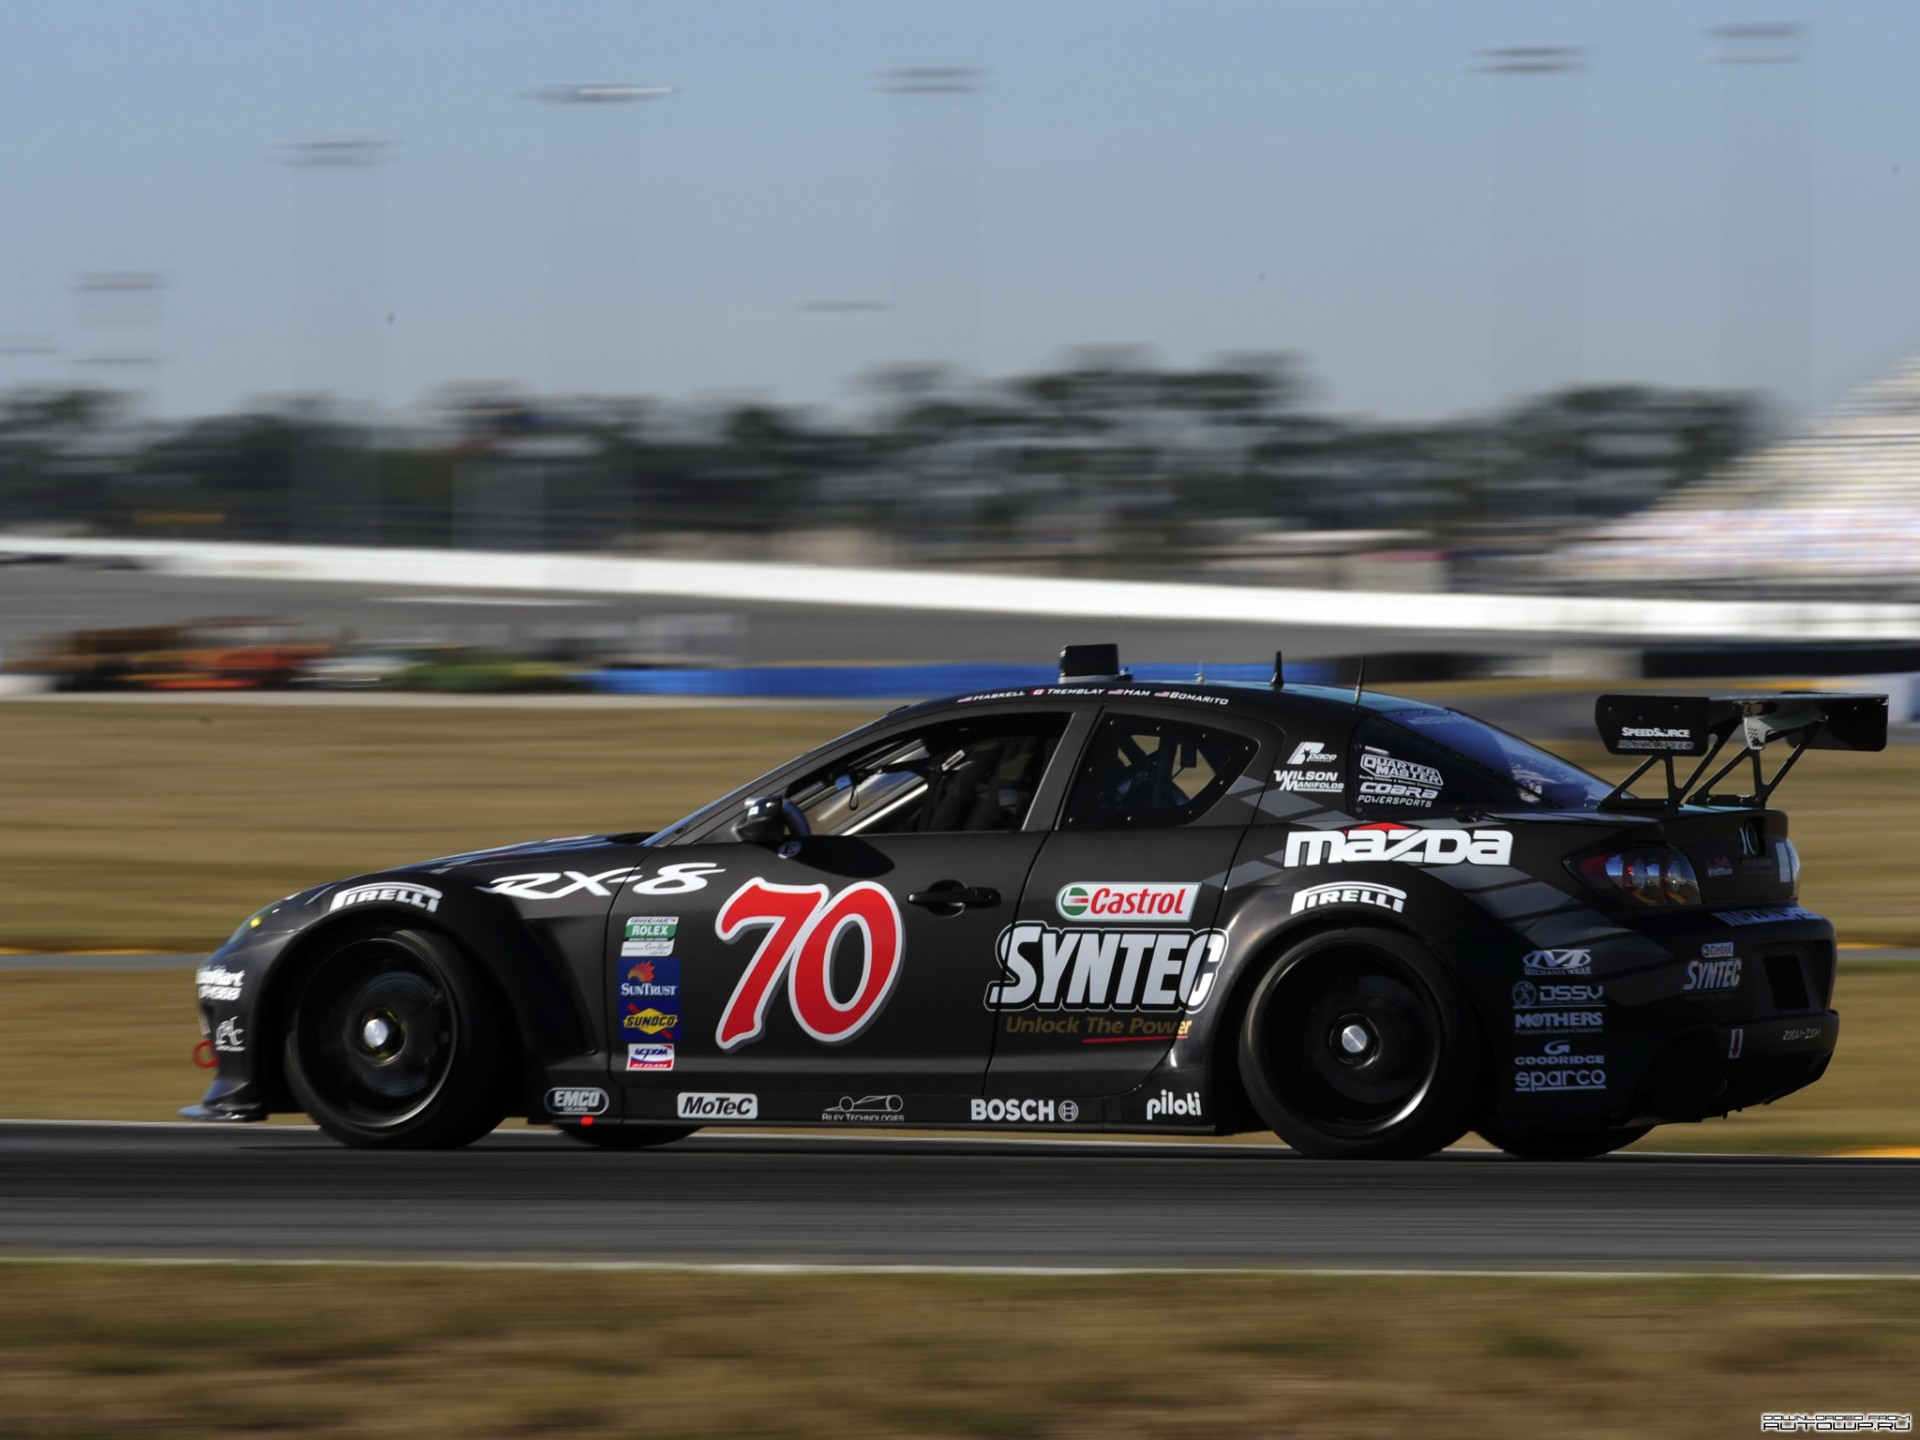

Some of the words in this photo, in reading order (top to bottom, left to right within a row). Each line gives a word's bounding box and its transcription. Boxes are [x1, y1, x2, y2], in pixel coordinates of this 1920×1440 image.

[972, 690, 1025, 701] HASKELL
[1047, 688, 1104, 696] TREMBLAY
[1122, 689, 1150, 697] HAM
[1167, 691, 1229, 706] BOMARITO
[1363, 755, 1438, 776] QUARTER
[1375, 765, 1439, 784] MASTER
[1274, 770, 1338, 782] WILSON
[1279, 781, 1344, 791] MANIFOLDS
[1358, 795, 1432, 808] POWERSPORTS
[475, 862, 726, 899] RX-8
[329, 882, 443, 913] PIRELLI
[1090, 888, 1186, 914] Castrol
[1291, 881, 1407, 915] PIRELLI
[631, 925, 669, 937] ROLEX
[715, 877, 905, 1052] 70
[987, 922, 1227, 1010] SYNTEC
[1682, 959, 1742, 991] SYNTEC
[1539, 985, 1604, 1001] DSSV
[626, 1015, 676, 1027] SUNOCO
[1006, 1016, 1079, 1034] Unlock
[1086, 1017, 1125, 1034] The
[1129, 1017, 1193, 1036] Power
[1515, 1012, 1603, 1028] MOTHERS
[1515, 1055, 1604, 1065] GOODRIDGE
[1515, 1069, 1606, 1091] sparco
[553, 1090, 600, 1107] EMCO
[682, 1096, 753, 1115] MoTeC
[1146, 1089, 1202, 1120] piloti
[971, 1098, 1055, 1122] BOSCH
